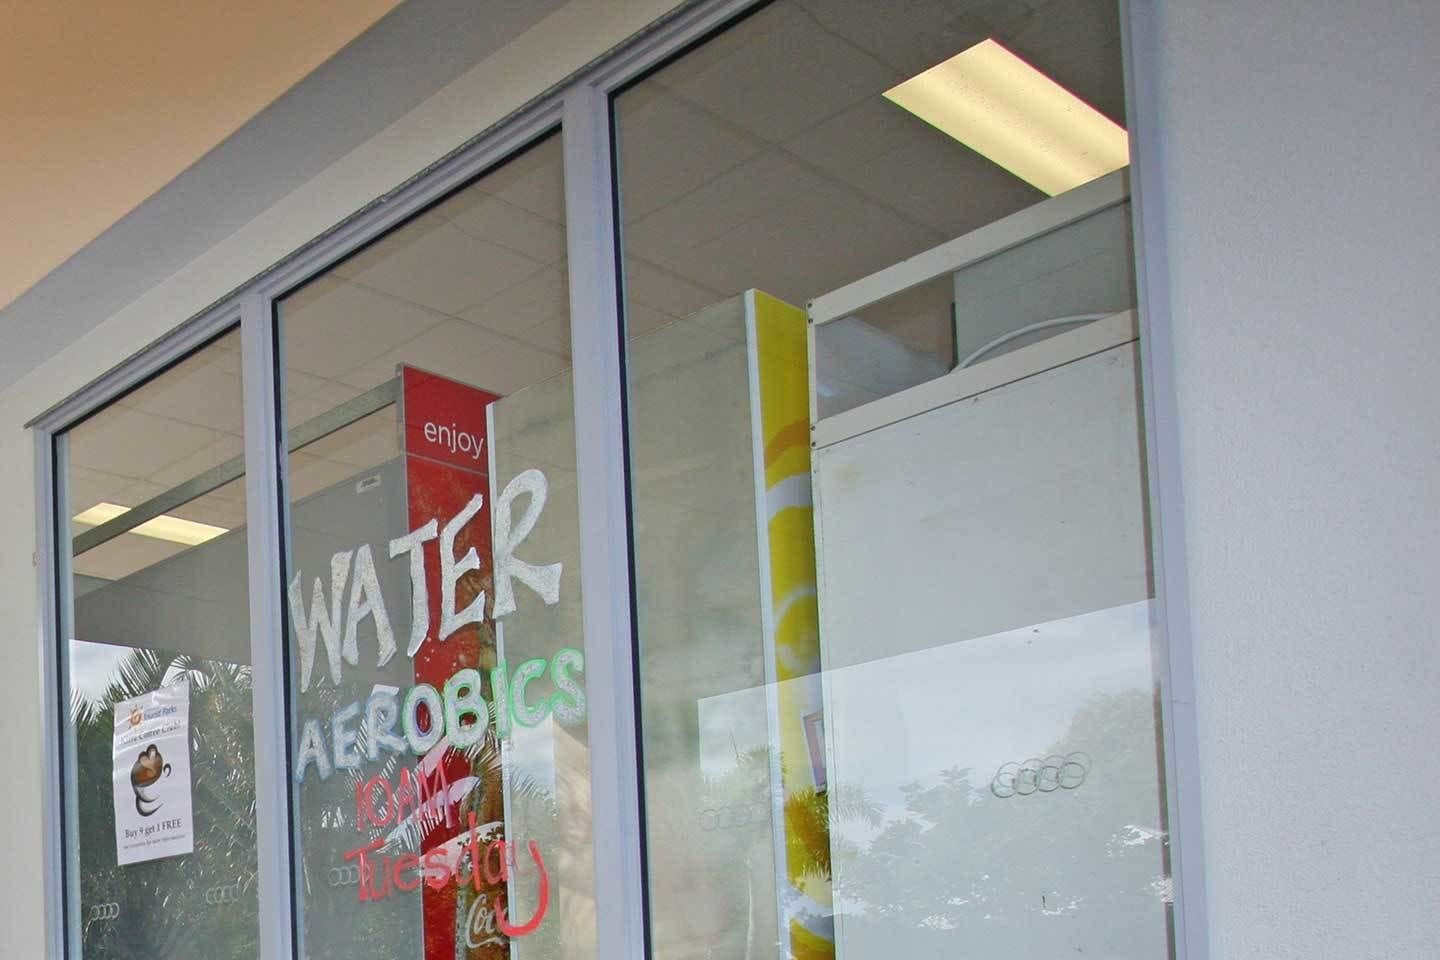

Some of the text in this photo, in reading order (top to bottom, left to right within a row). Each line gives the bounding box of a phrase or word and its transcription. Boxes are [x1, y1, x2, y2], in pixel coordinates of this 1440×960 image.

[424, 420, 485, 460] enjoy
[287, 468, 563, 693] WATER
[295, 647, 585, 784] AEROBICS
[125, 828, 138, 839] Buy
[144, 825, 156, 837] get
[162, 818, 182, 831] FREE
[343, 811, 550, 937] Tuesday
